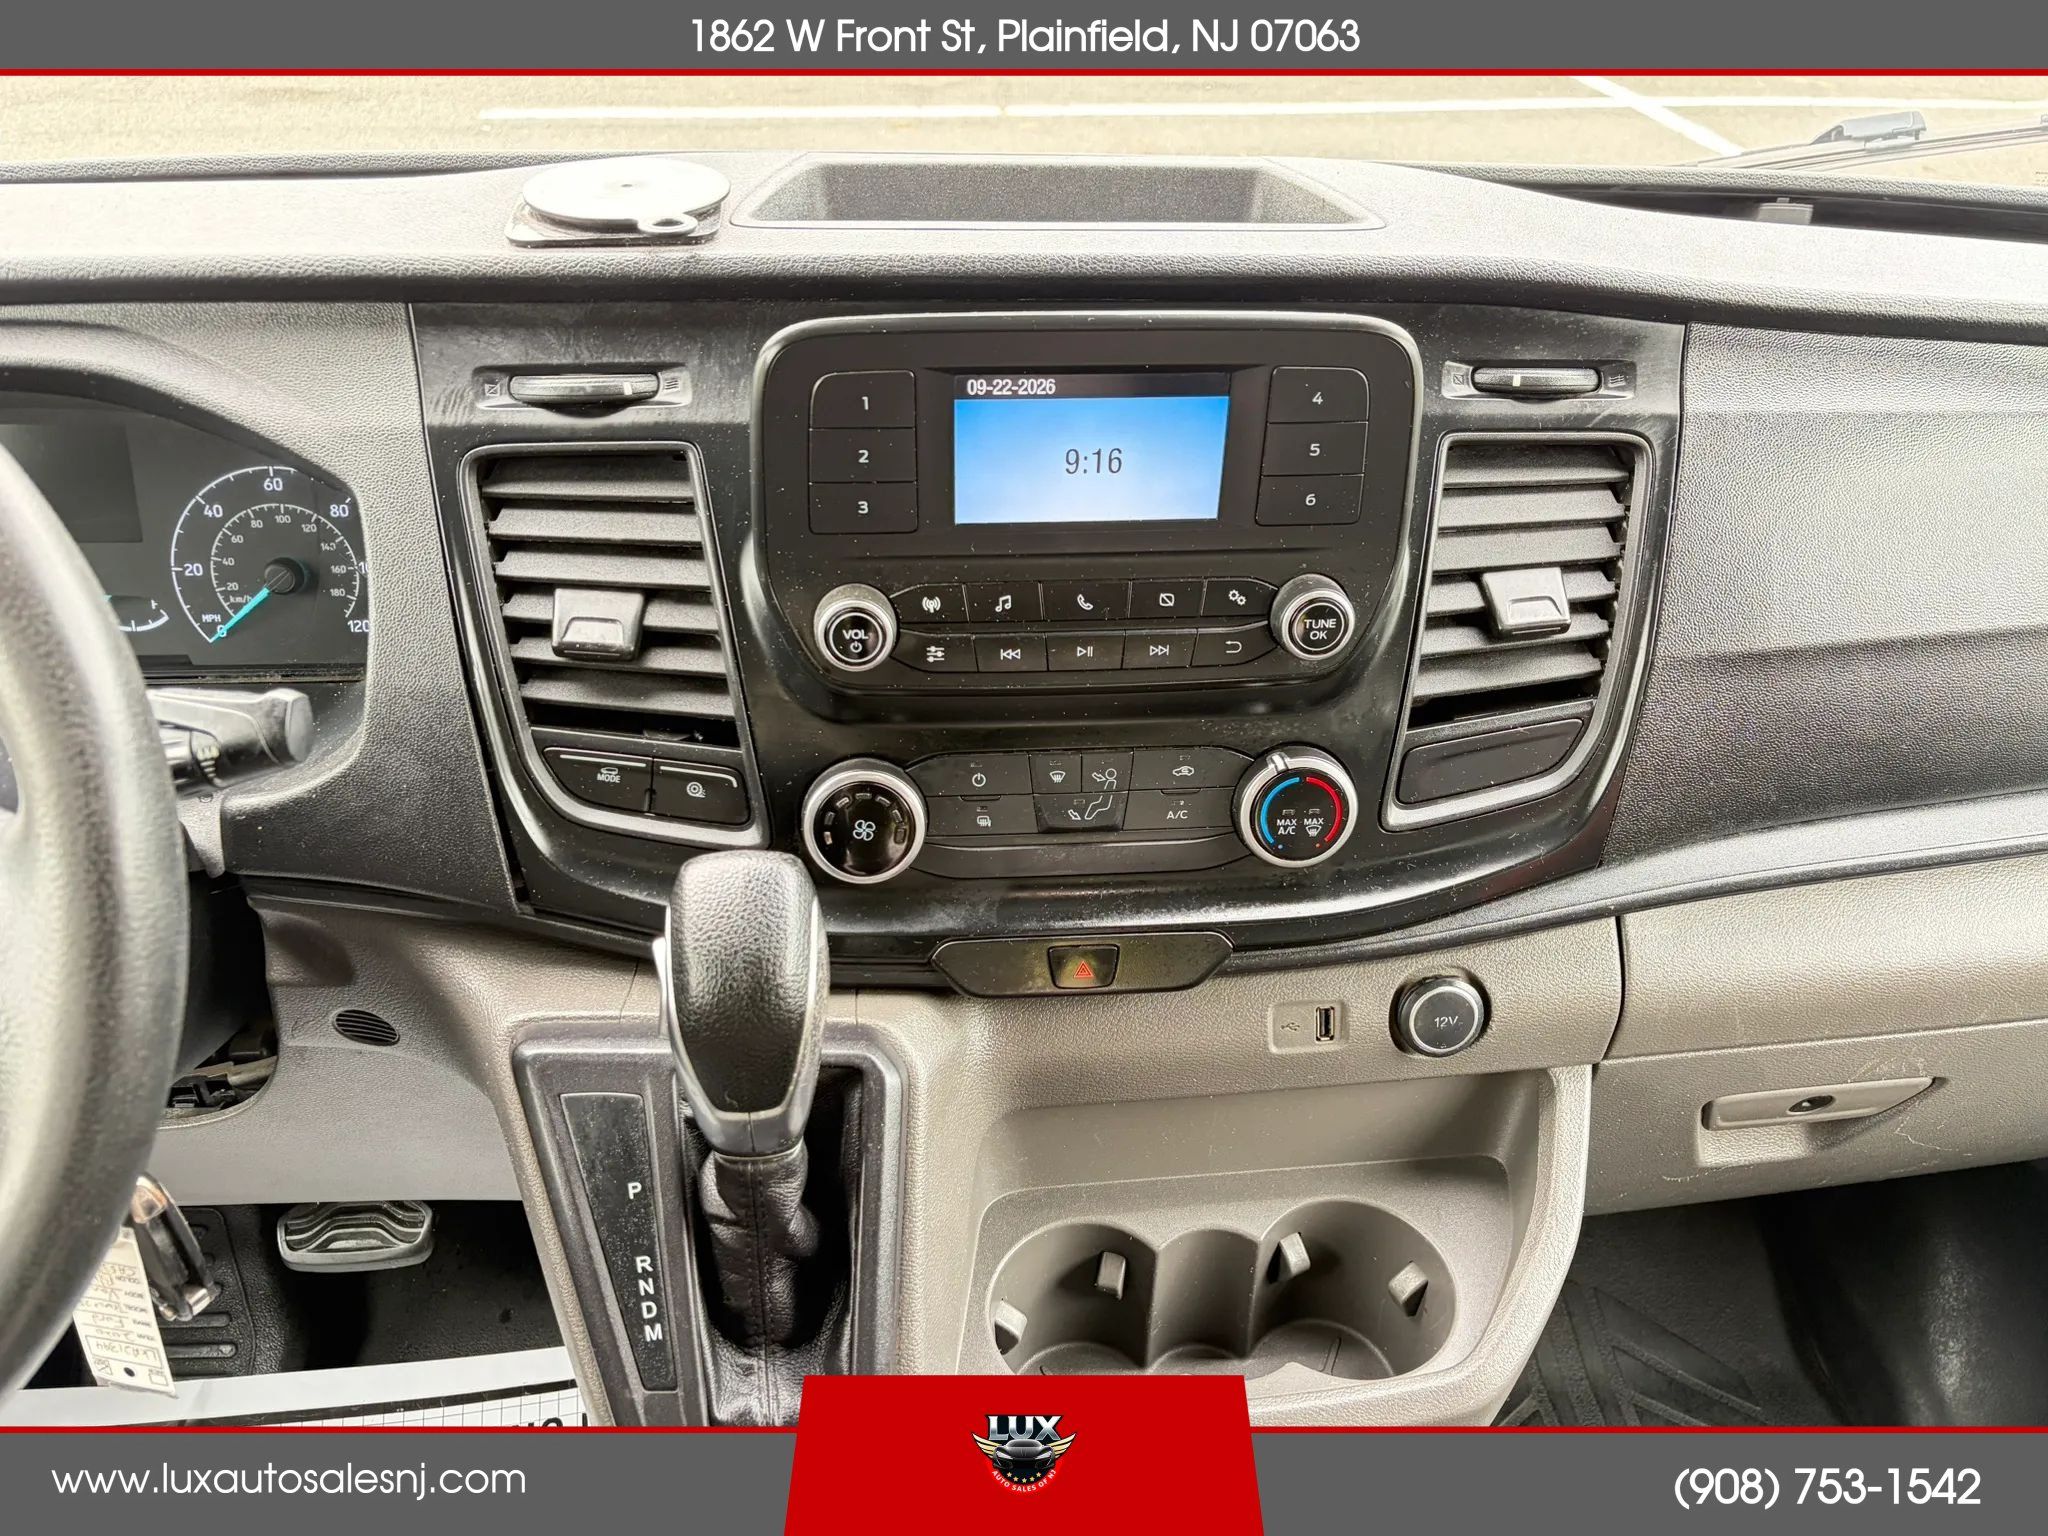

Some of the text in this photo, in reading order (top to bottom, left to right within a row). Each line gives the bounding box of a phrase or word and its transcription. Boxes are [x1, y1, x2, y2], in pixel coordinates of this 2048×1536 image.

[967, 378, 1057, 396] 09-22-2026
[861, 396, 870, 411] 1
[1311, 392, 1324, 405] 4
[1309, 443, 1321, 457] 5
[858, 450, 870, 464] 2
[1065, 447, 1123, 475] 9:16
[263, 477, 284, 492] 60
[1305, 493, 1317, 507] 6
[203, 504, 224, 518] 40
[329, 504, 349, 518] 80
[857, 501, 870, 515] 3
[250, 519, 264, 529] 80
[274, 515, 292, 524] 100
[301, 523, 318, 533] 120
[231, 534, 244, 544] 60
[222, 557, 235, 567] 40
[183, 563, 204, 577] 20
[330, 565, 347, 574] 160
[226, 582, 240, 591] 20
[329, 588, 346, 597] 180
[201, 613, 222, 623] MPH
[1303, 618, 1337, 629] TUNE
[842, 628, 869, 640] VOL
[1309, 630, 1328, 640] OK
[596, 772, 621, 784] MODE
[1166, 809, 1189, 821] A/C
[1303, 817, 1325, 826] MAX
[1276, 818, 1297, 826] MAX
[1277, 826, 1296, 835] A/C
[1433, 1014, 1459, 1029] 12V
[627, 1181, 643, 1200] P
[635, 1255, 654, 1274] R
[638, 1278, 655, 1297] N
[641, 1301, 658, 1319] D
[644, 1323, 664, 1342] M
